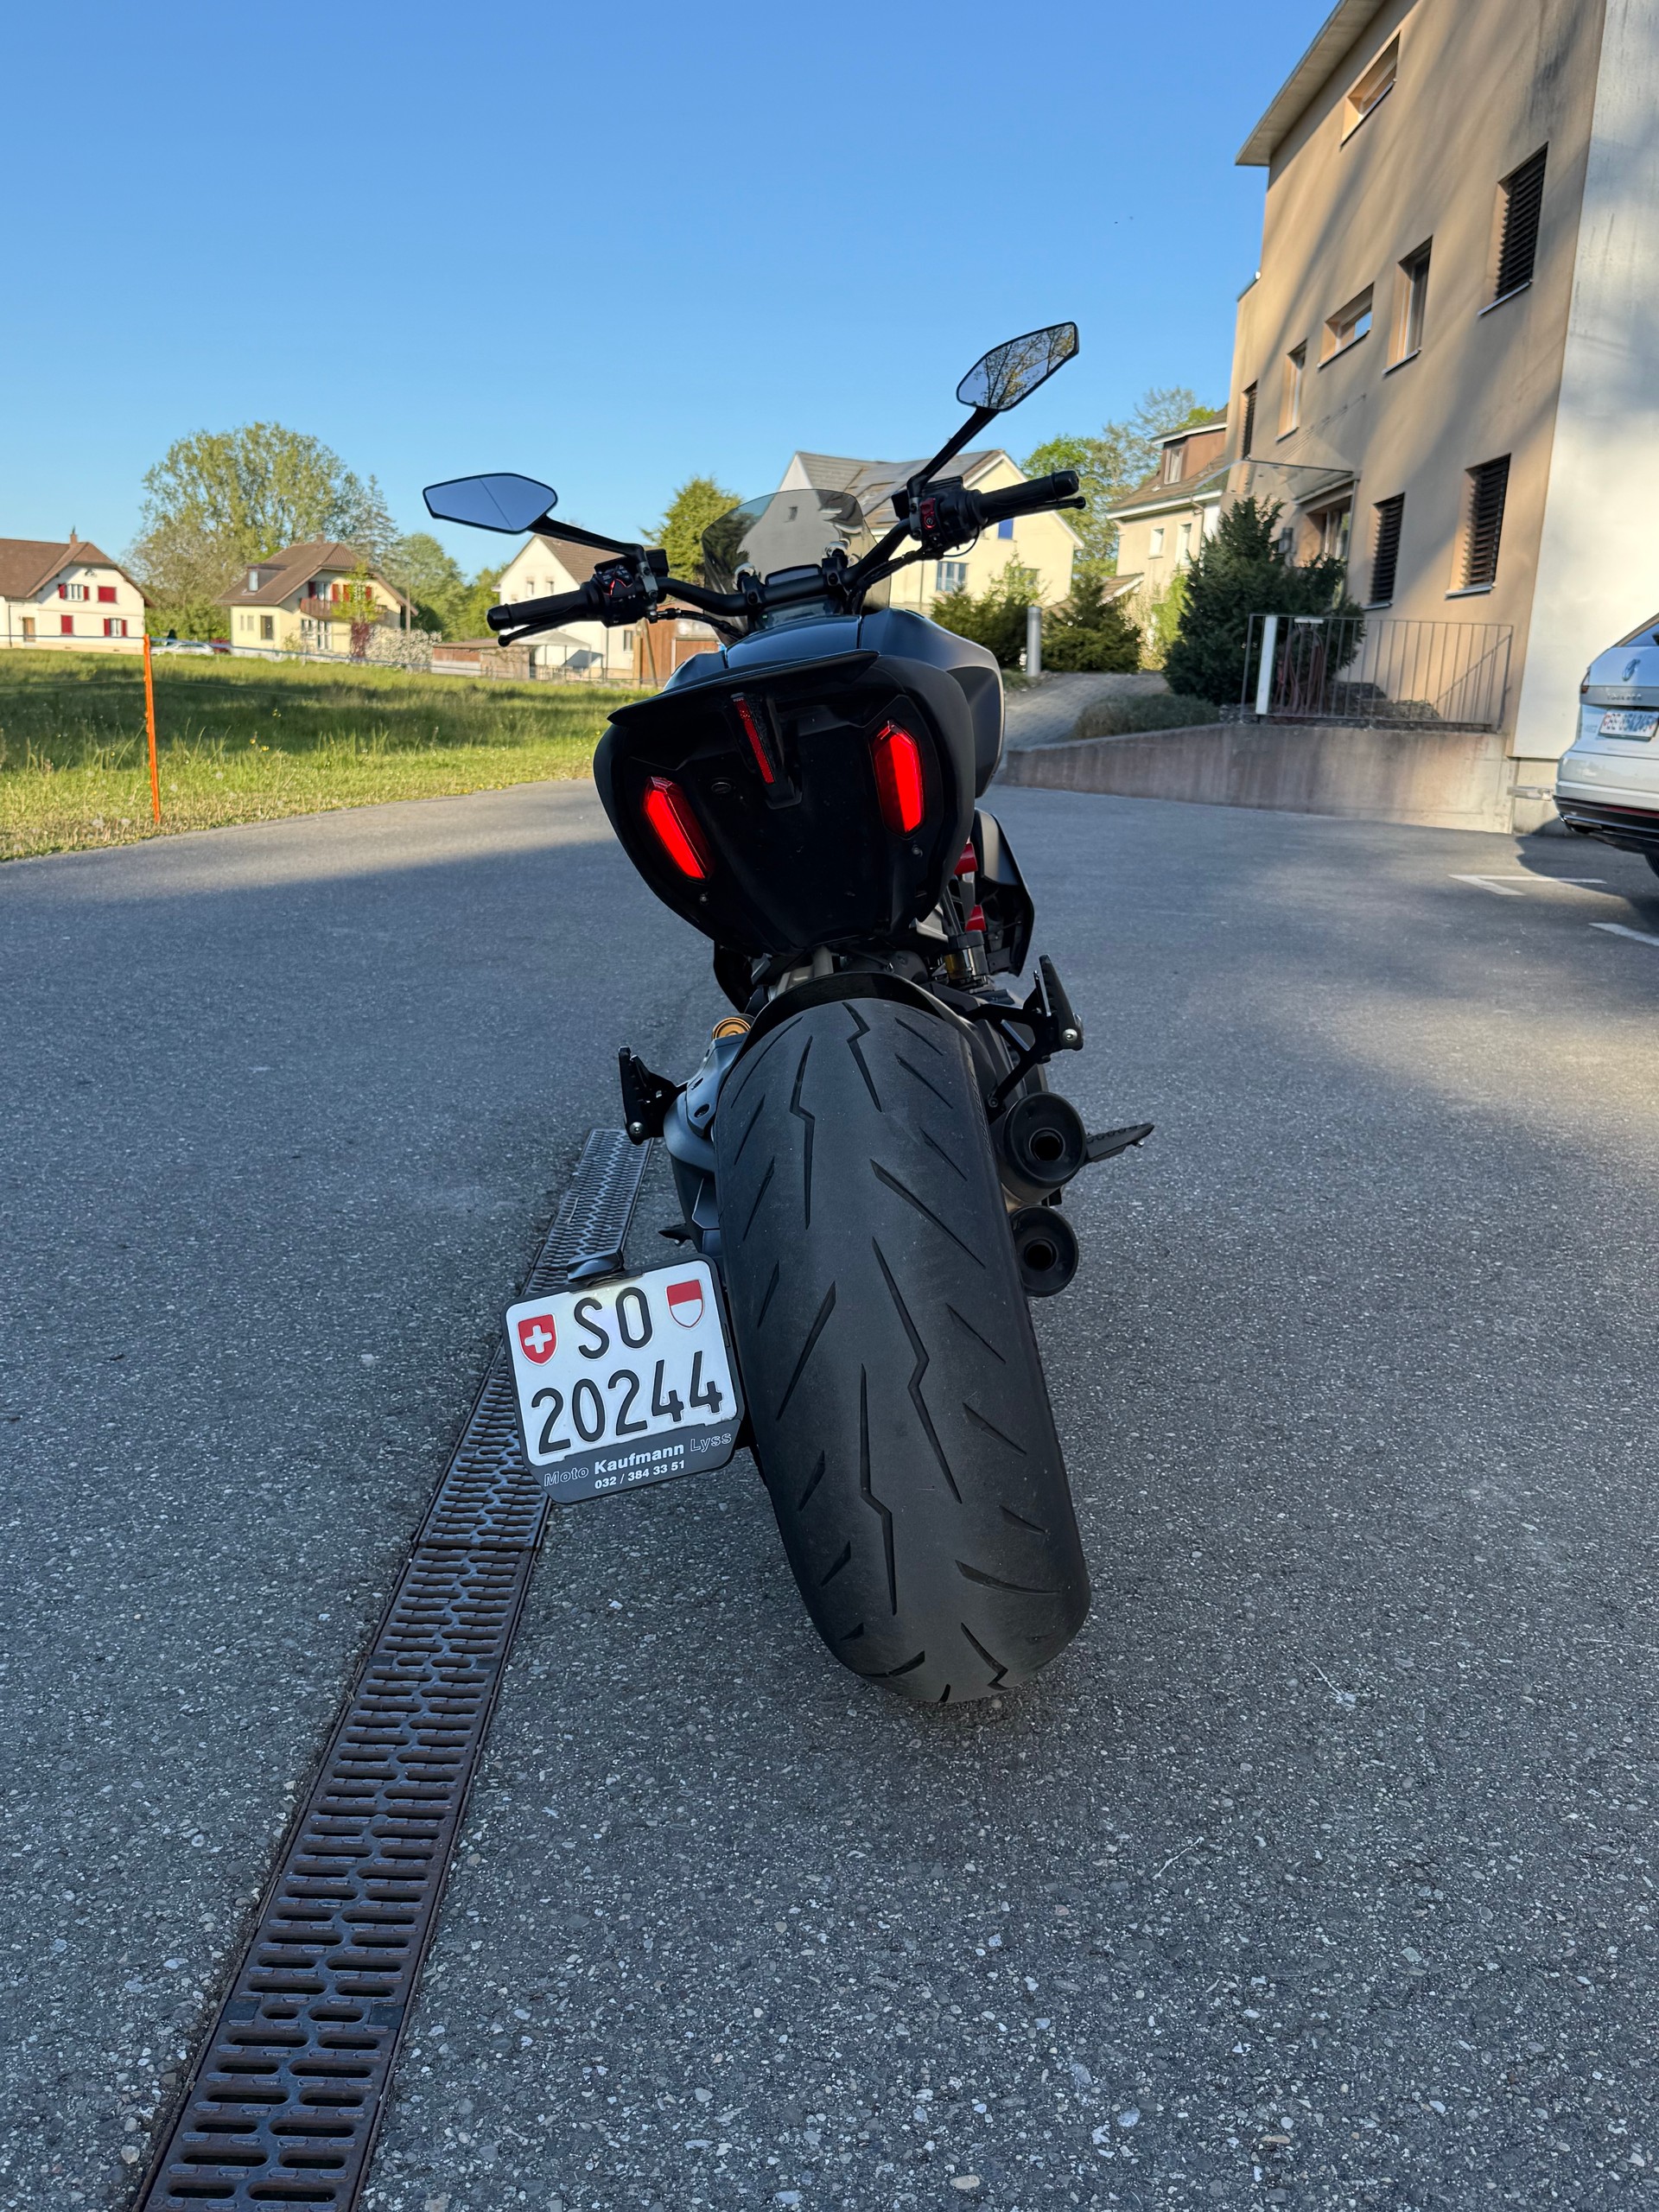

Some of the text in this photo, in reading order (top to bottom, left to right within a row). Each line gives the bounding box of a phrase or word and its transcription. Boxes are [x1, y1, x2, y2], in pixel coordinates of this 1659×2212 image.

[574, 1287, 653, 1359] SO
[531, 1351, 723, 1454] 20244
[543, 1433, 732, 1487] Moto Kaufmann Lyss
[594, 1459, 685, 1489] 032 / 384 33 51
